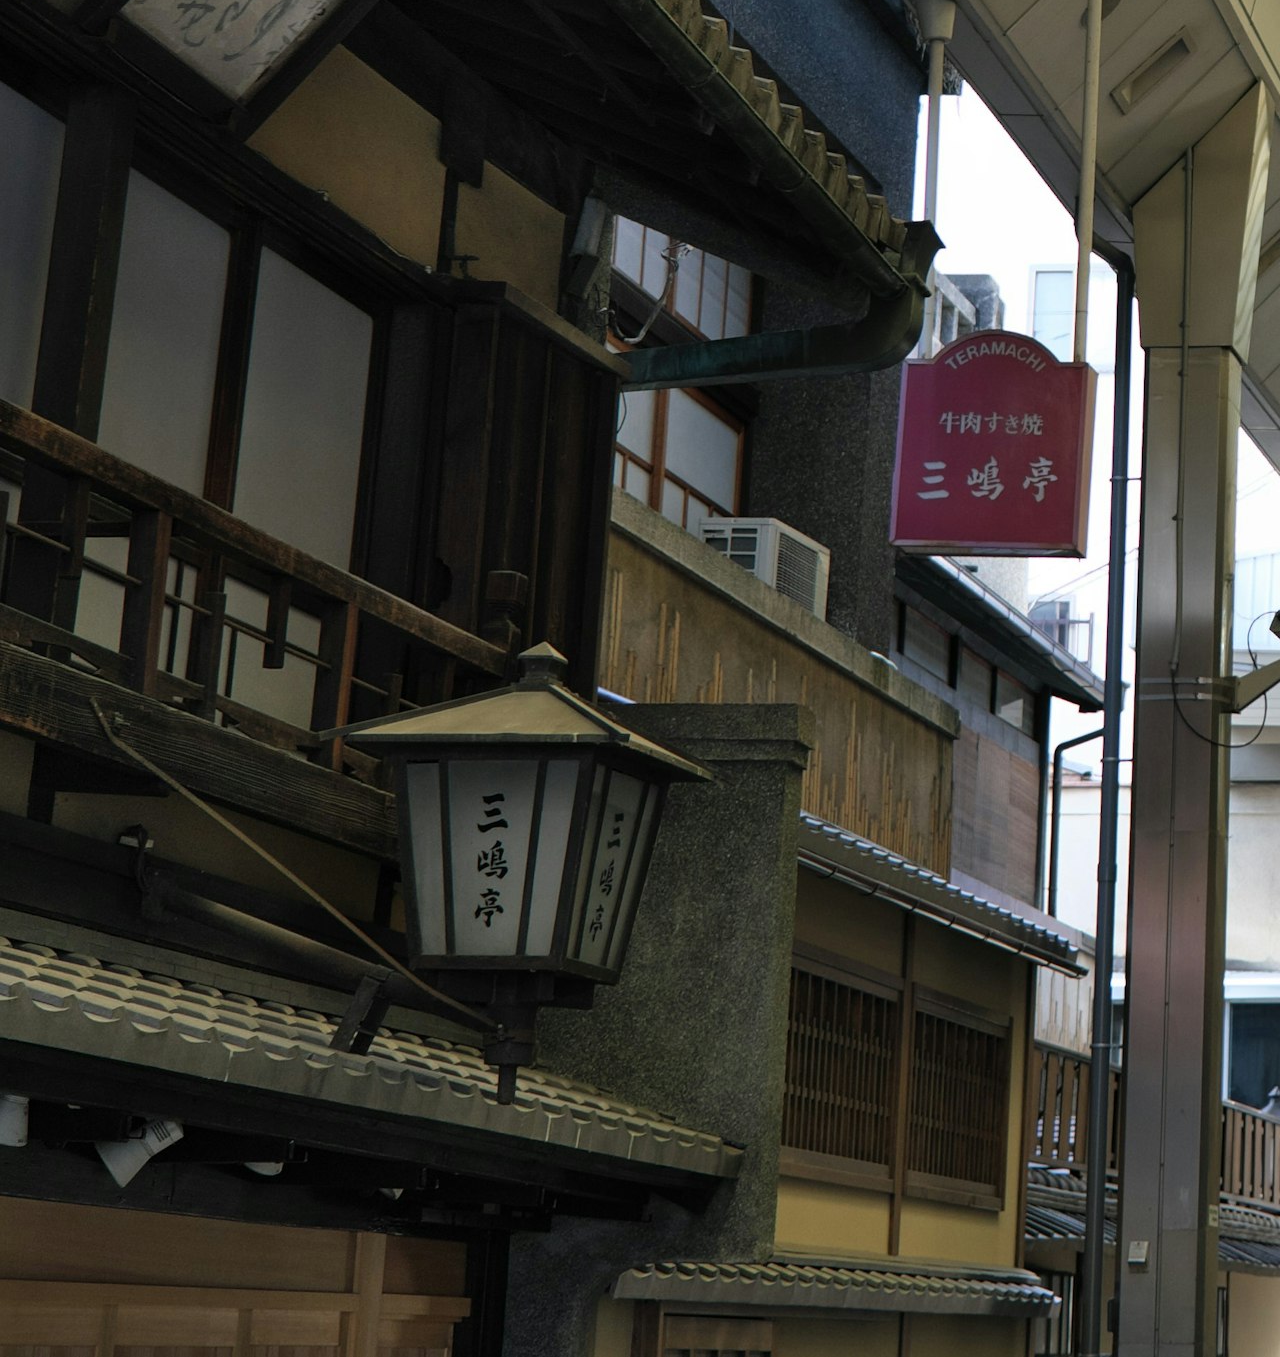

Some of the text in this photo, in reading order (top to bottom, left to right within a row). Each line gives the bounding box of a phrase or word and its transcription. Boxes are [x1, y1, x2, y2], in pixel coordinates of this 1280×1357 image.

[945, 342, 1047, 372] TERAMACHI
[939, 412, 1043, 435] 牛肉すき焼
[916, 456, 1058, 502] 三嶋亭
[475, 793, 509, 928] 三嶋亭
[589, 812, 625, 942] 三嶋亭
